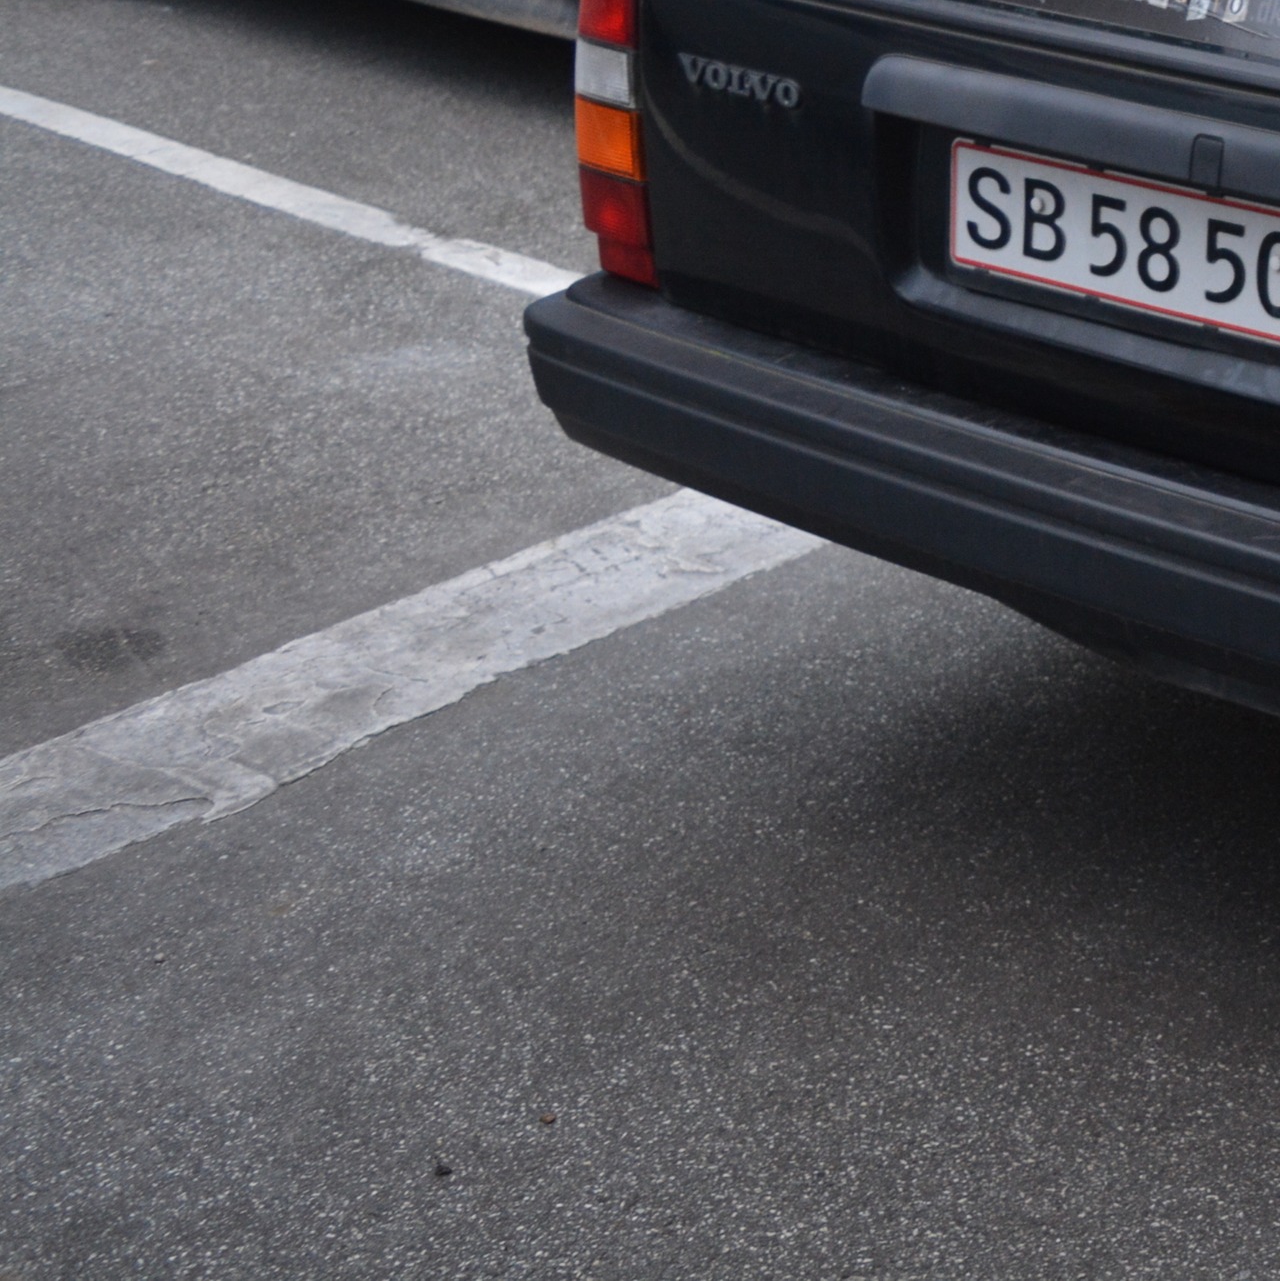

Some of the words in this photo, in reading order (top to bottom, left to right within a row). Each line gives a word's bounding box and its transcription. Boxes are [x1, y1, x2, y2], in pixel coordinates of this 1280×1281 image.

[678, 52, 800, 108] VOLVO
[966, 166, 1067, 262] SB
[1089, 193, 1181, 293] 58
